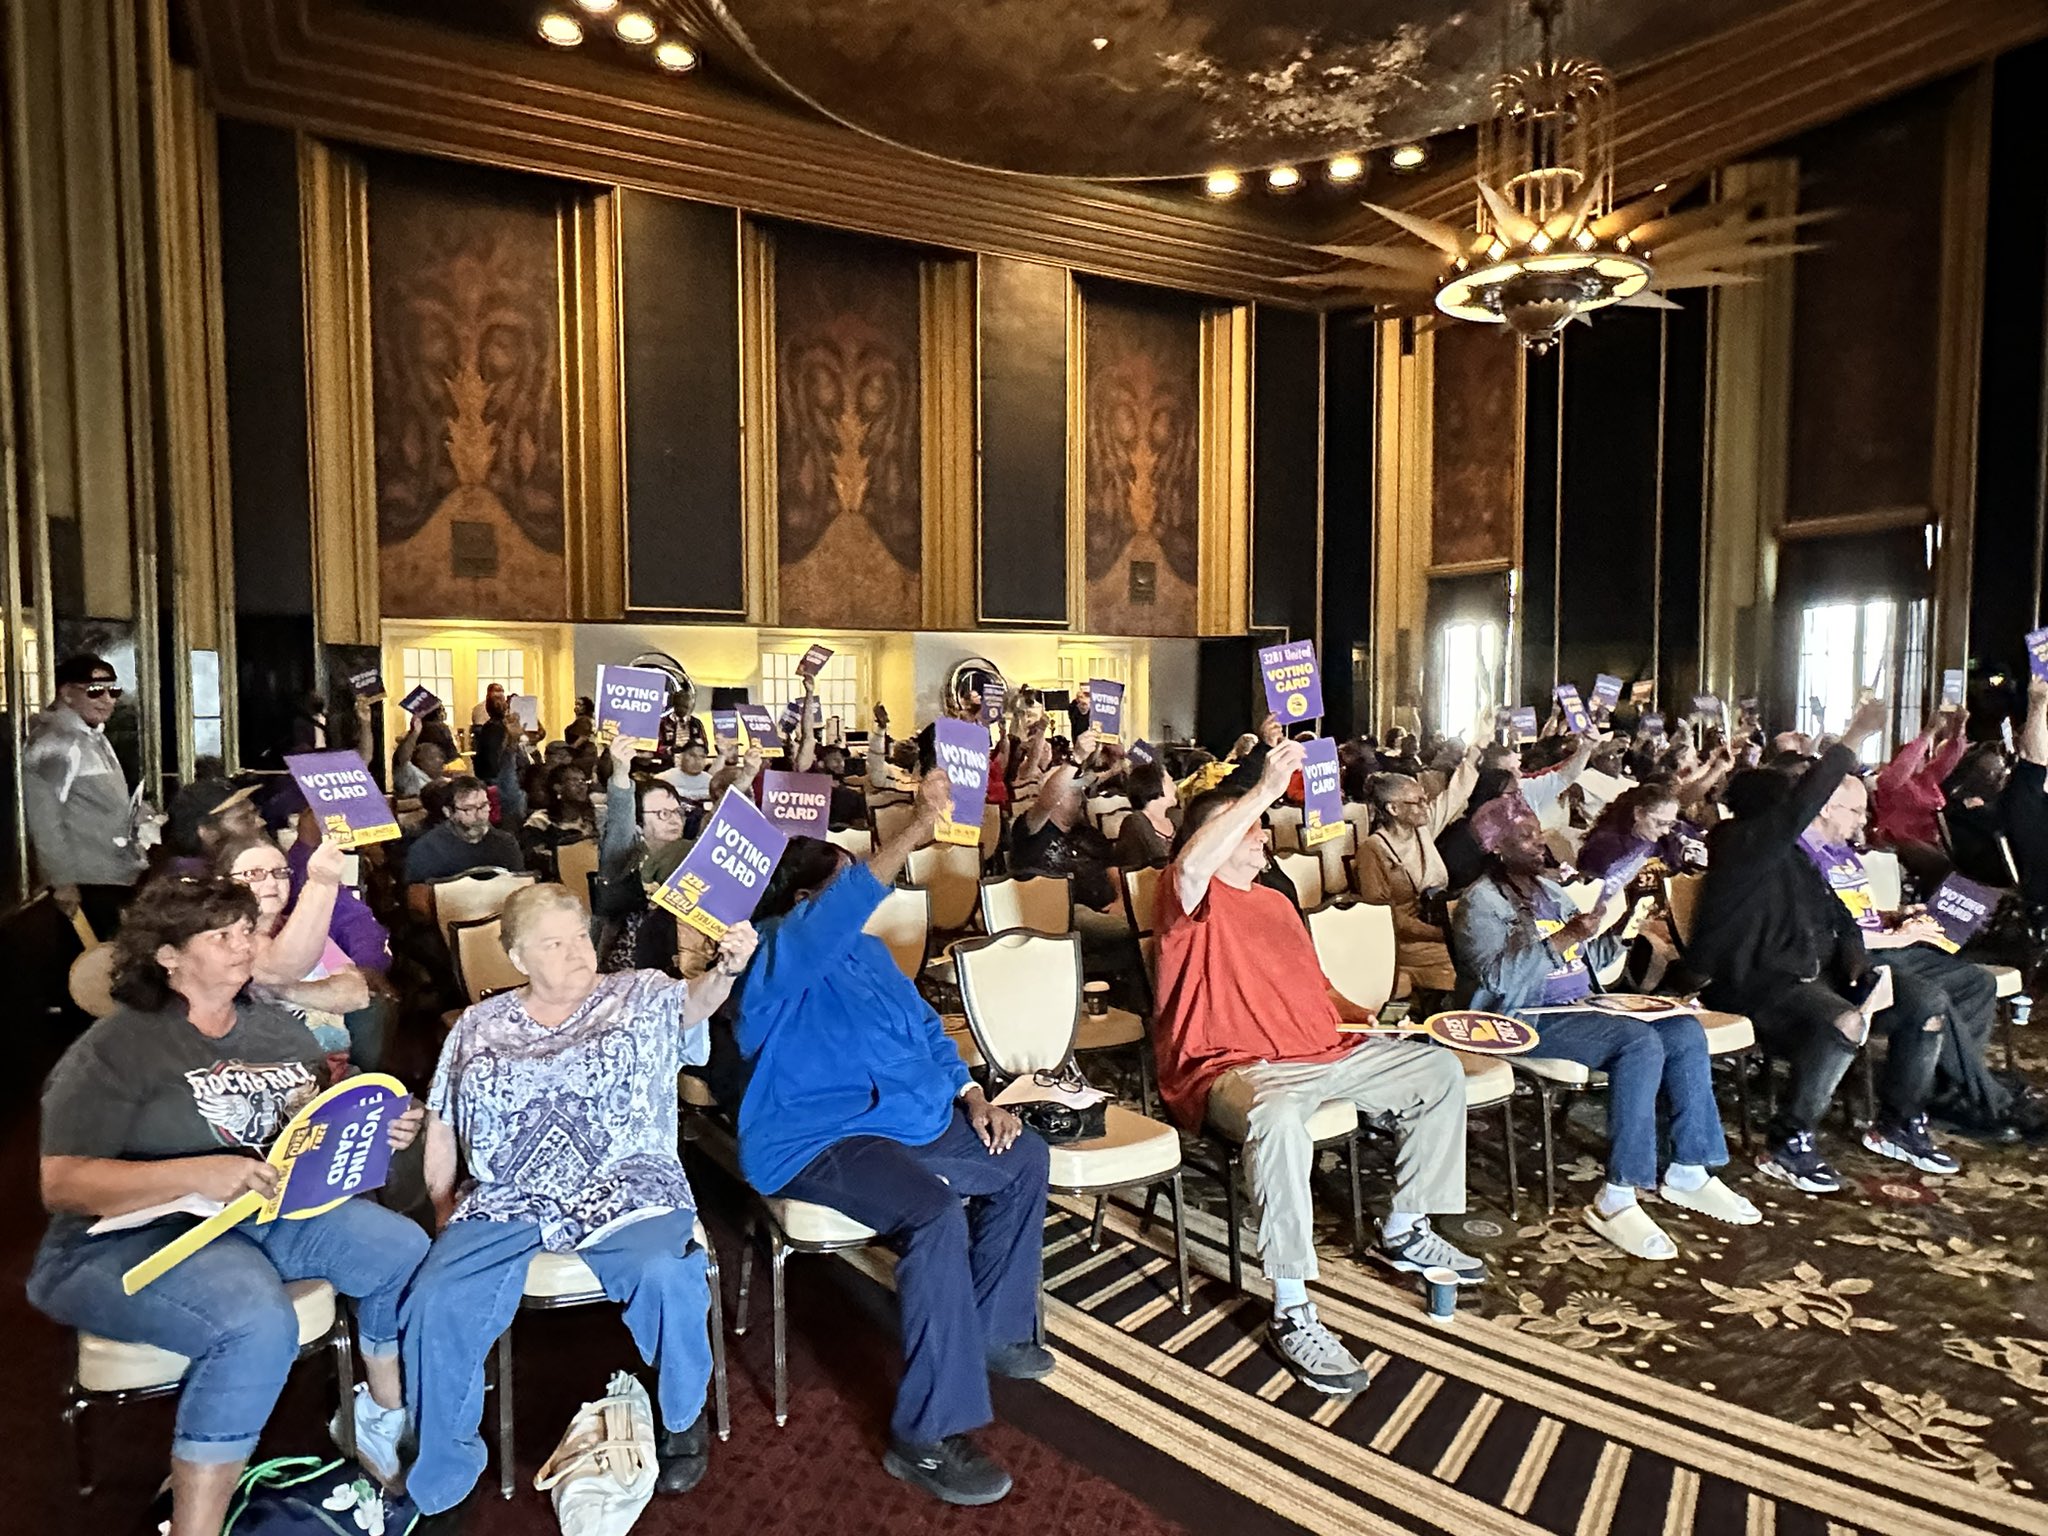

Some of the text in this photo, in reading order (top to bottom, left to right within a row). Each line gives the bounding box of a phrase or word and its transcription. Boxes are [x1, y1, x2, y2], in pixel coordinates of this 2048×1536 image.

[1266, 662, 1315, 682] VOTING
[605, 683, 659, 701] VOTING
[1275, 676, 1311, 693] CARD
[610, 697, 652, 713] CARD
[1091, 692, 1120, 705] VOTING
[1095, 703, 1117, 715] CARD
[940, 741, 987, 771] VOTING
[301, 769, 368, 788] VOTING
[948, 763, 981, 789] CARD
[1304, 760, 1338, 780] VOTING
[318, 784, 368, 801] CARD
[1311, 777, 1336, 795] CARD
[768, 790, 826, 807] VOTING
[774, 806, 818, 821] CARD
[715, 818, 771, 877] VOTING
[711, 845, 757, 888] CARD
[666, 889, 695, 911] SEIU
[1940, 886, 1986, 915] VOTING
[1937, 899, 1974, 923] CARD
[1443, 1017, 1471, 1042] SEIU
[327, 1122, 360, 1186] CARD
[342, 1106, 385, 1191] VOTING
